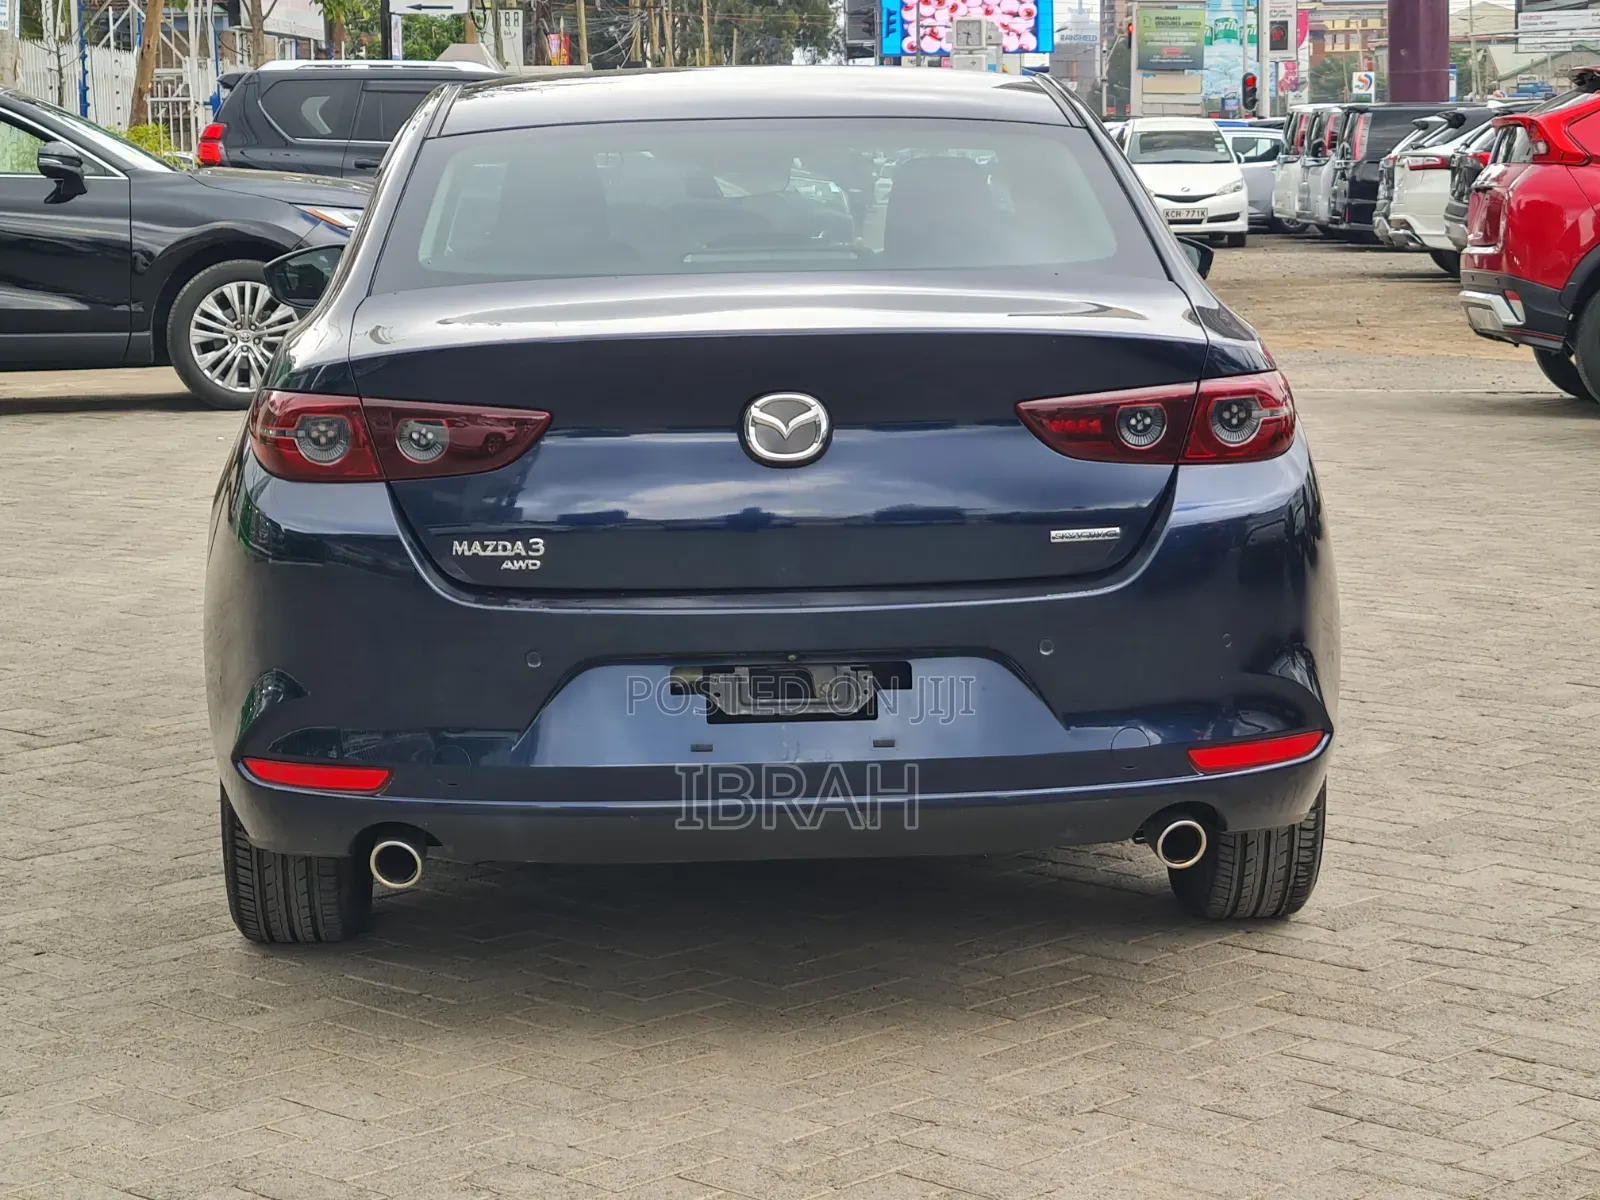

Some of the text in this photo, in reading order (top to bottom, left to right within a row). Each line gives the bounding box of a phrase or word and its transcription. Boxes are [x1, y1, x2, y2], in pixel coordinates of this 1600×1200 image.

[1165, 210, 1206, 218] KCH 771K
[500, 560, 541, 570] AWD
